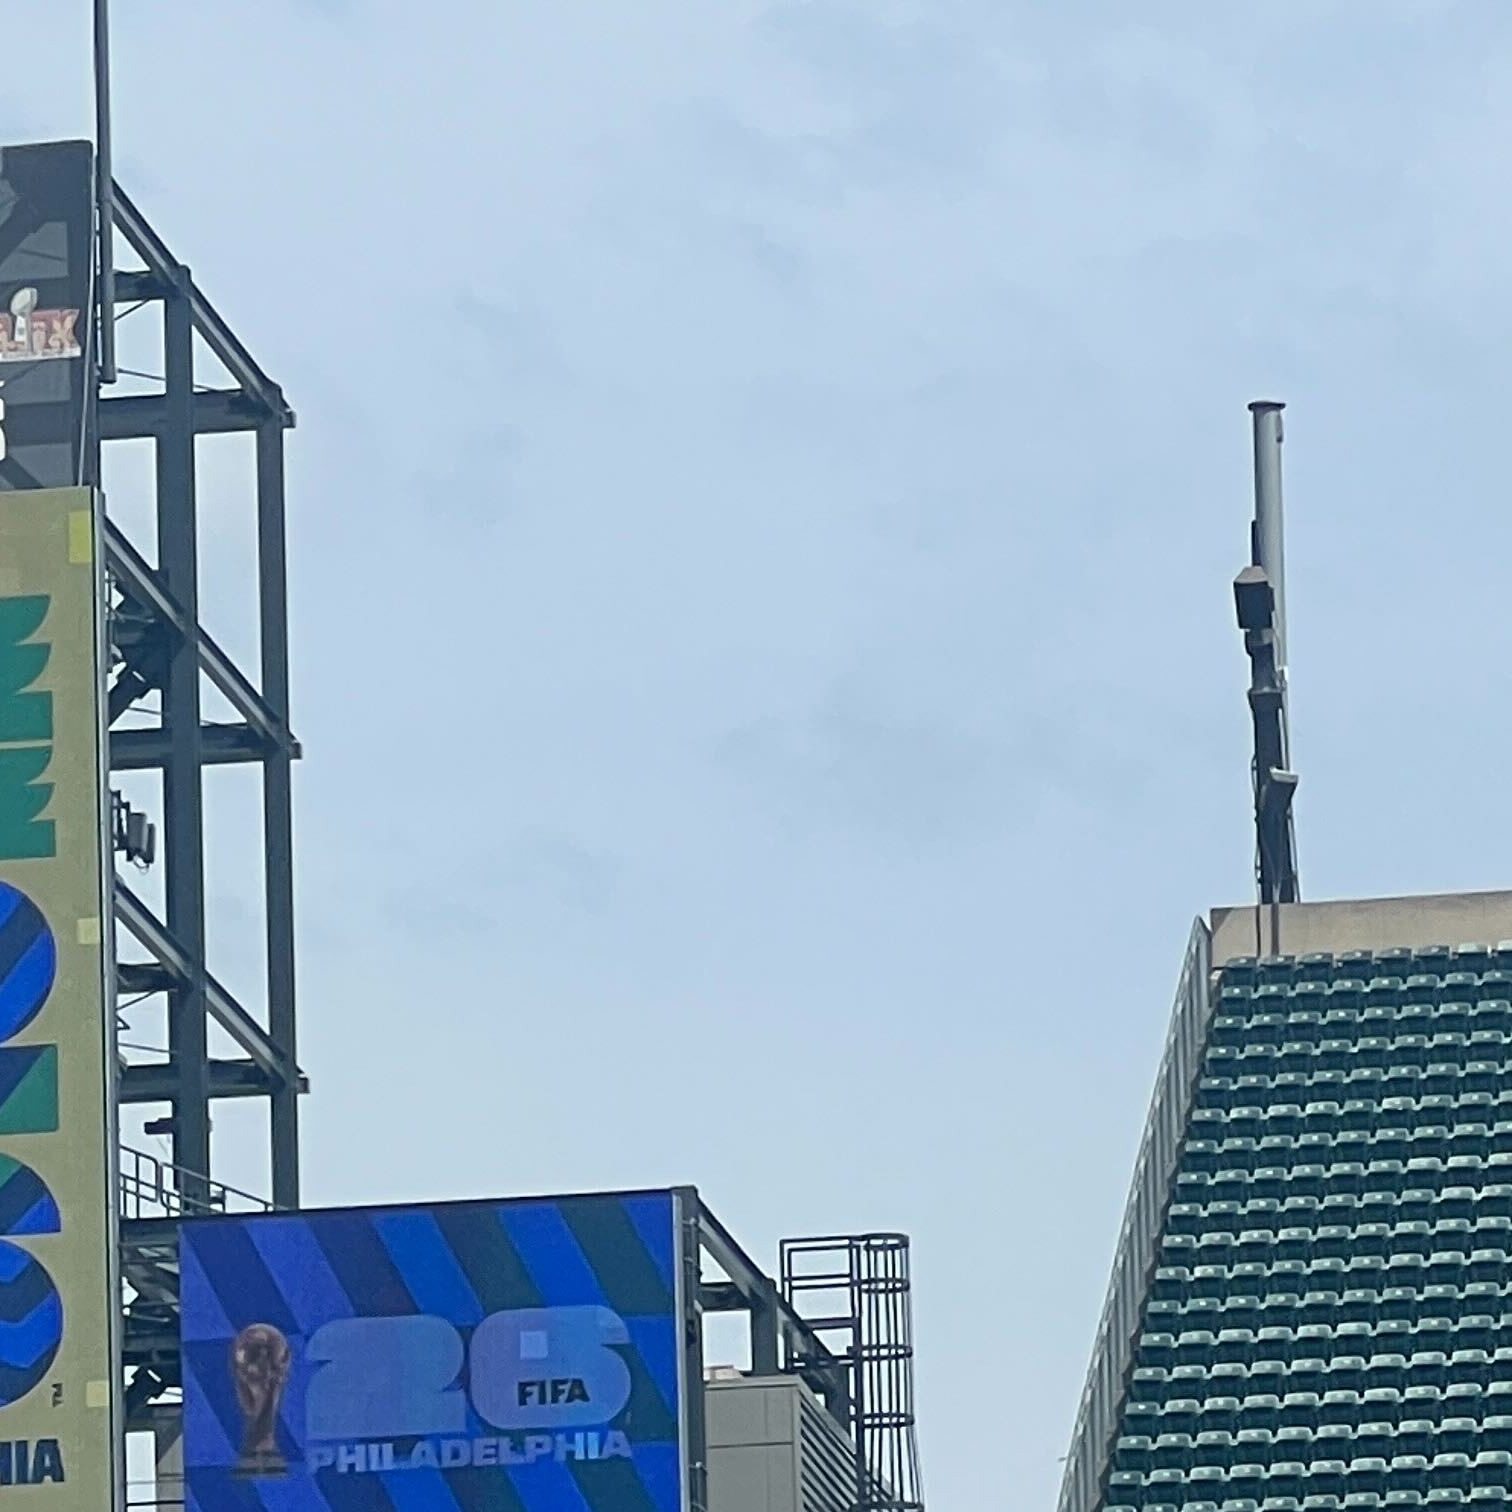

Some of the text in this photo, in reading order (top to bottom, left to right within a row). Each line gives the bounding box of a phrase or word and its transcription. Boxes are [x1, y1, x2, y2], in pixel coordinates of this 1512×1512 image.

[305, 1305, 632, 1440] 26
[518, 1378, 591, 1407] FIFA
[310, 1430, 633, 1475] PHILADELPHIA
